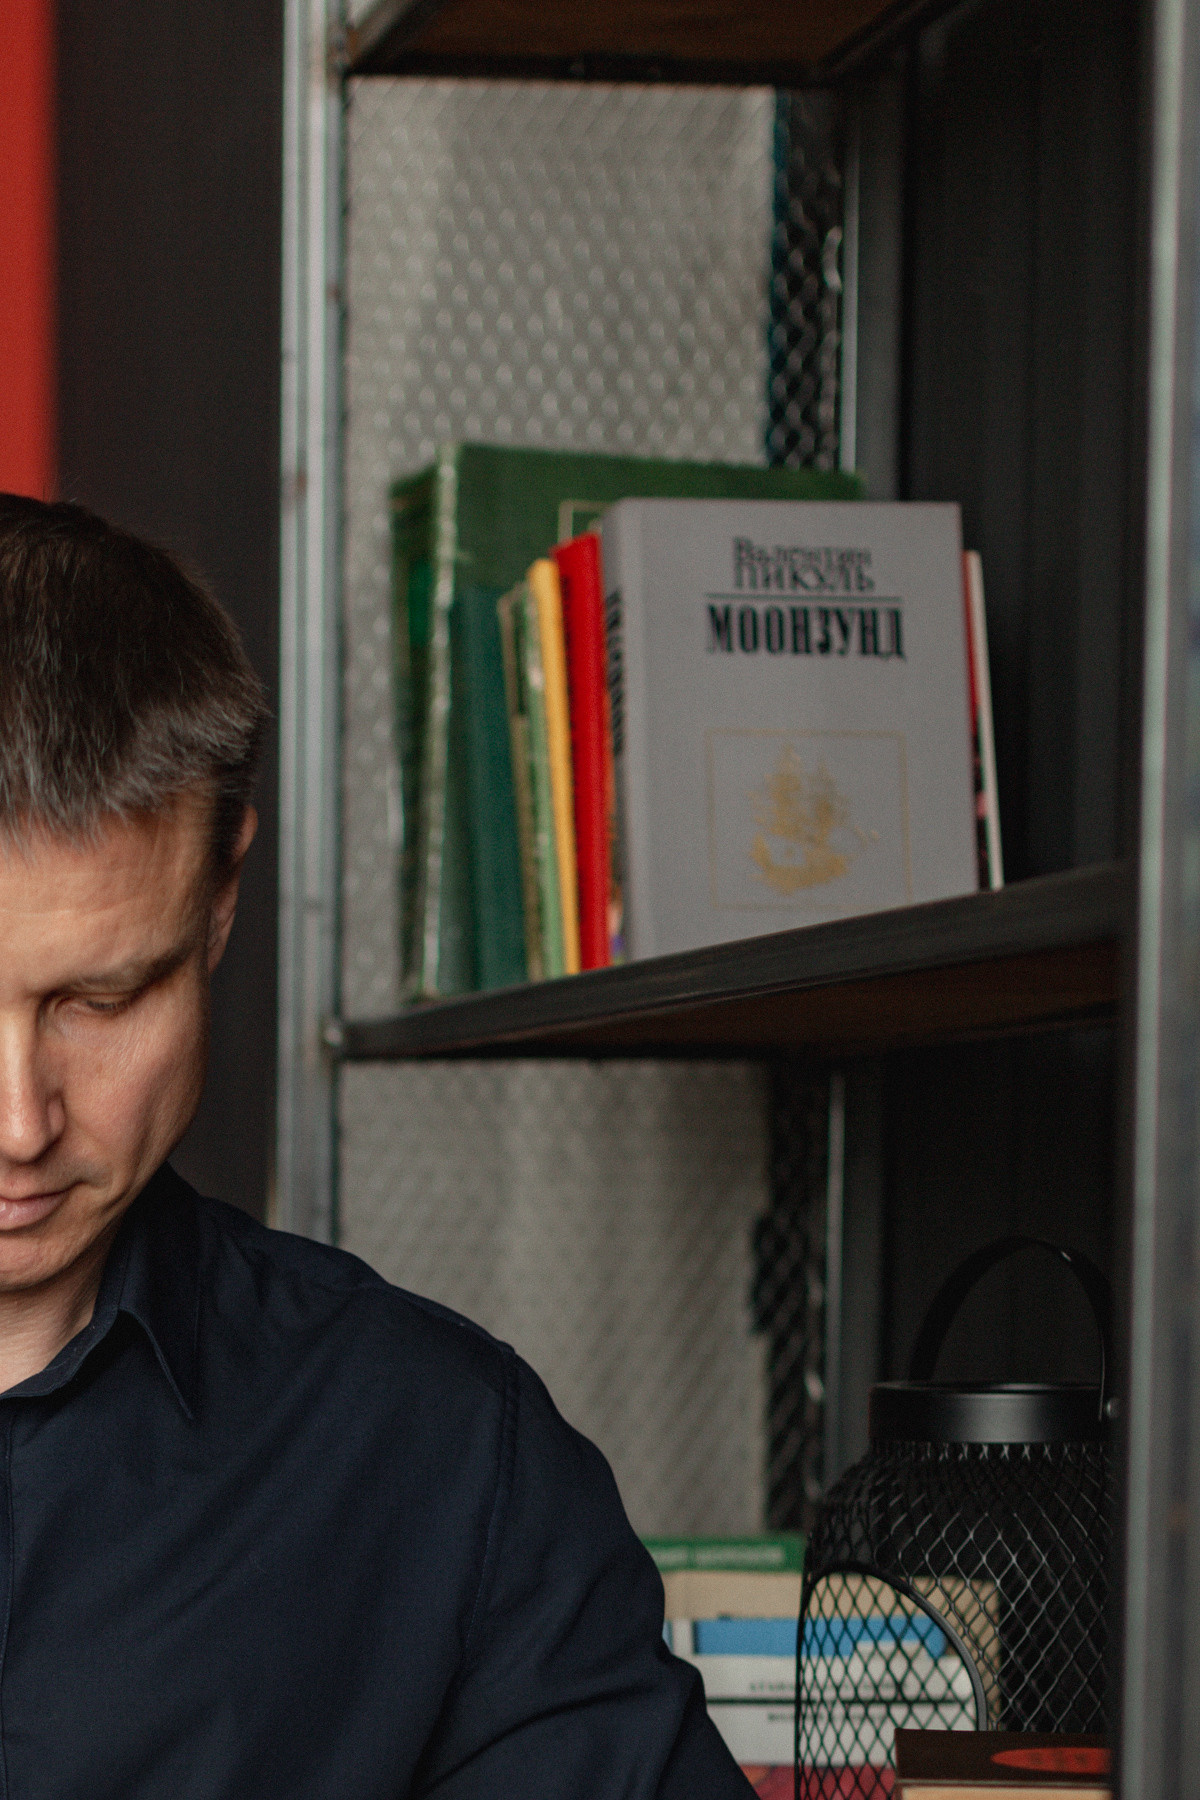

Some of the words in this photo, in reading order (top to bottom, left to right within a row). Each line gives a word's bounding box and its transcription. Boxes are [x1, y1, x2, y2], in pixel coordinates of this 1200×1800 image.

[733, 536, 873, 568] Валентин
[733, 562, 877, 593] ПИКУЛЬ
[706, 604, 908, 664] МООНЗУНД
